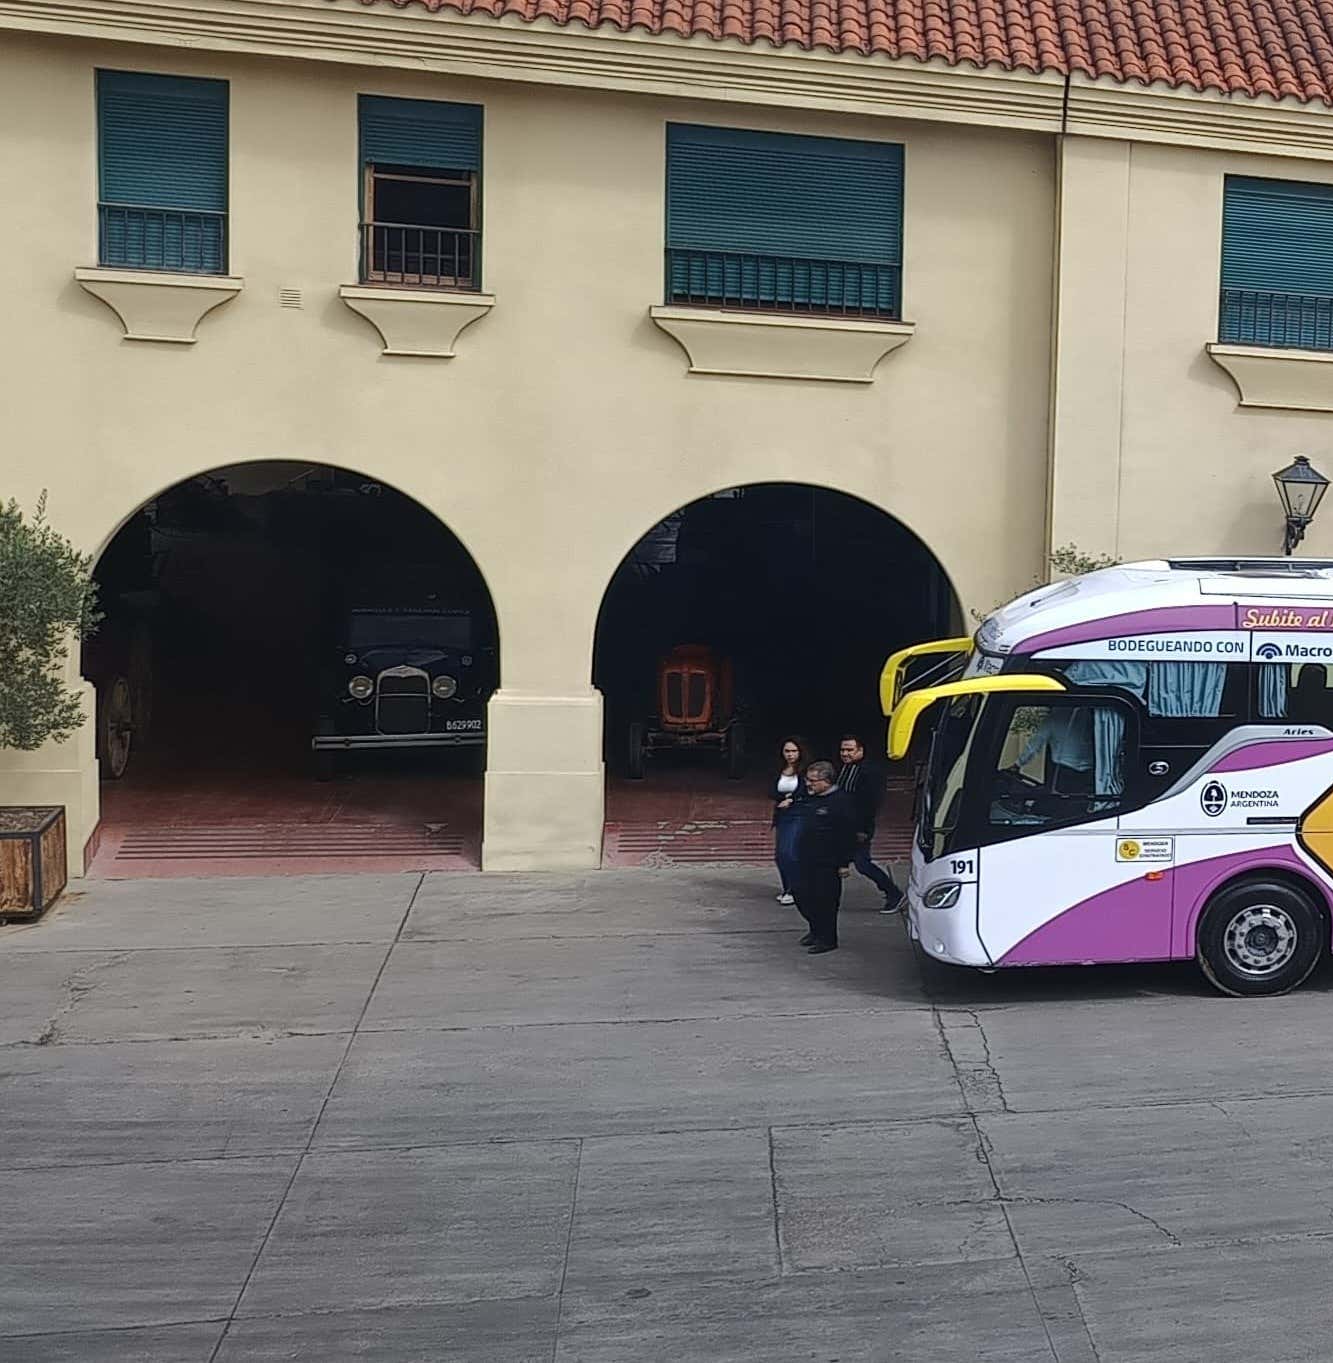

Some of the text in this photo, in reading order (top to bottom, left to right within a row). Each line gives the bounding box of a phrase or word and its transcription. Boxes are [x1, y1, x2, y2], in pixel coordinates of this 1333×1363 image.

[1242, 609, 1303, 629] Subite
[1306, 610, 1327, 628] al
[1107, 639, 1244, 654] BODEGUEANDO CON
[1284, 643, 1333, 658] Macro
[1282, 728, 1315, 736] Aries
[1230, 790, 1280, 800] MENDOZA
[1230, 800, 1280, 808] ARGENTINA
[949, 859, 974, 875] 191
